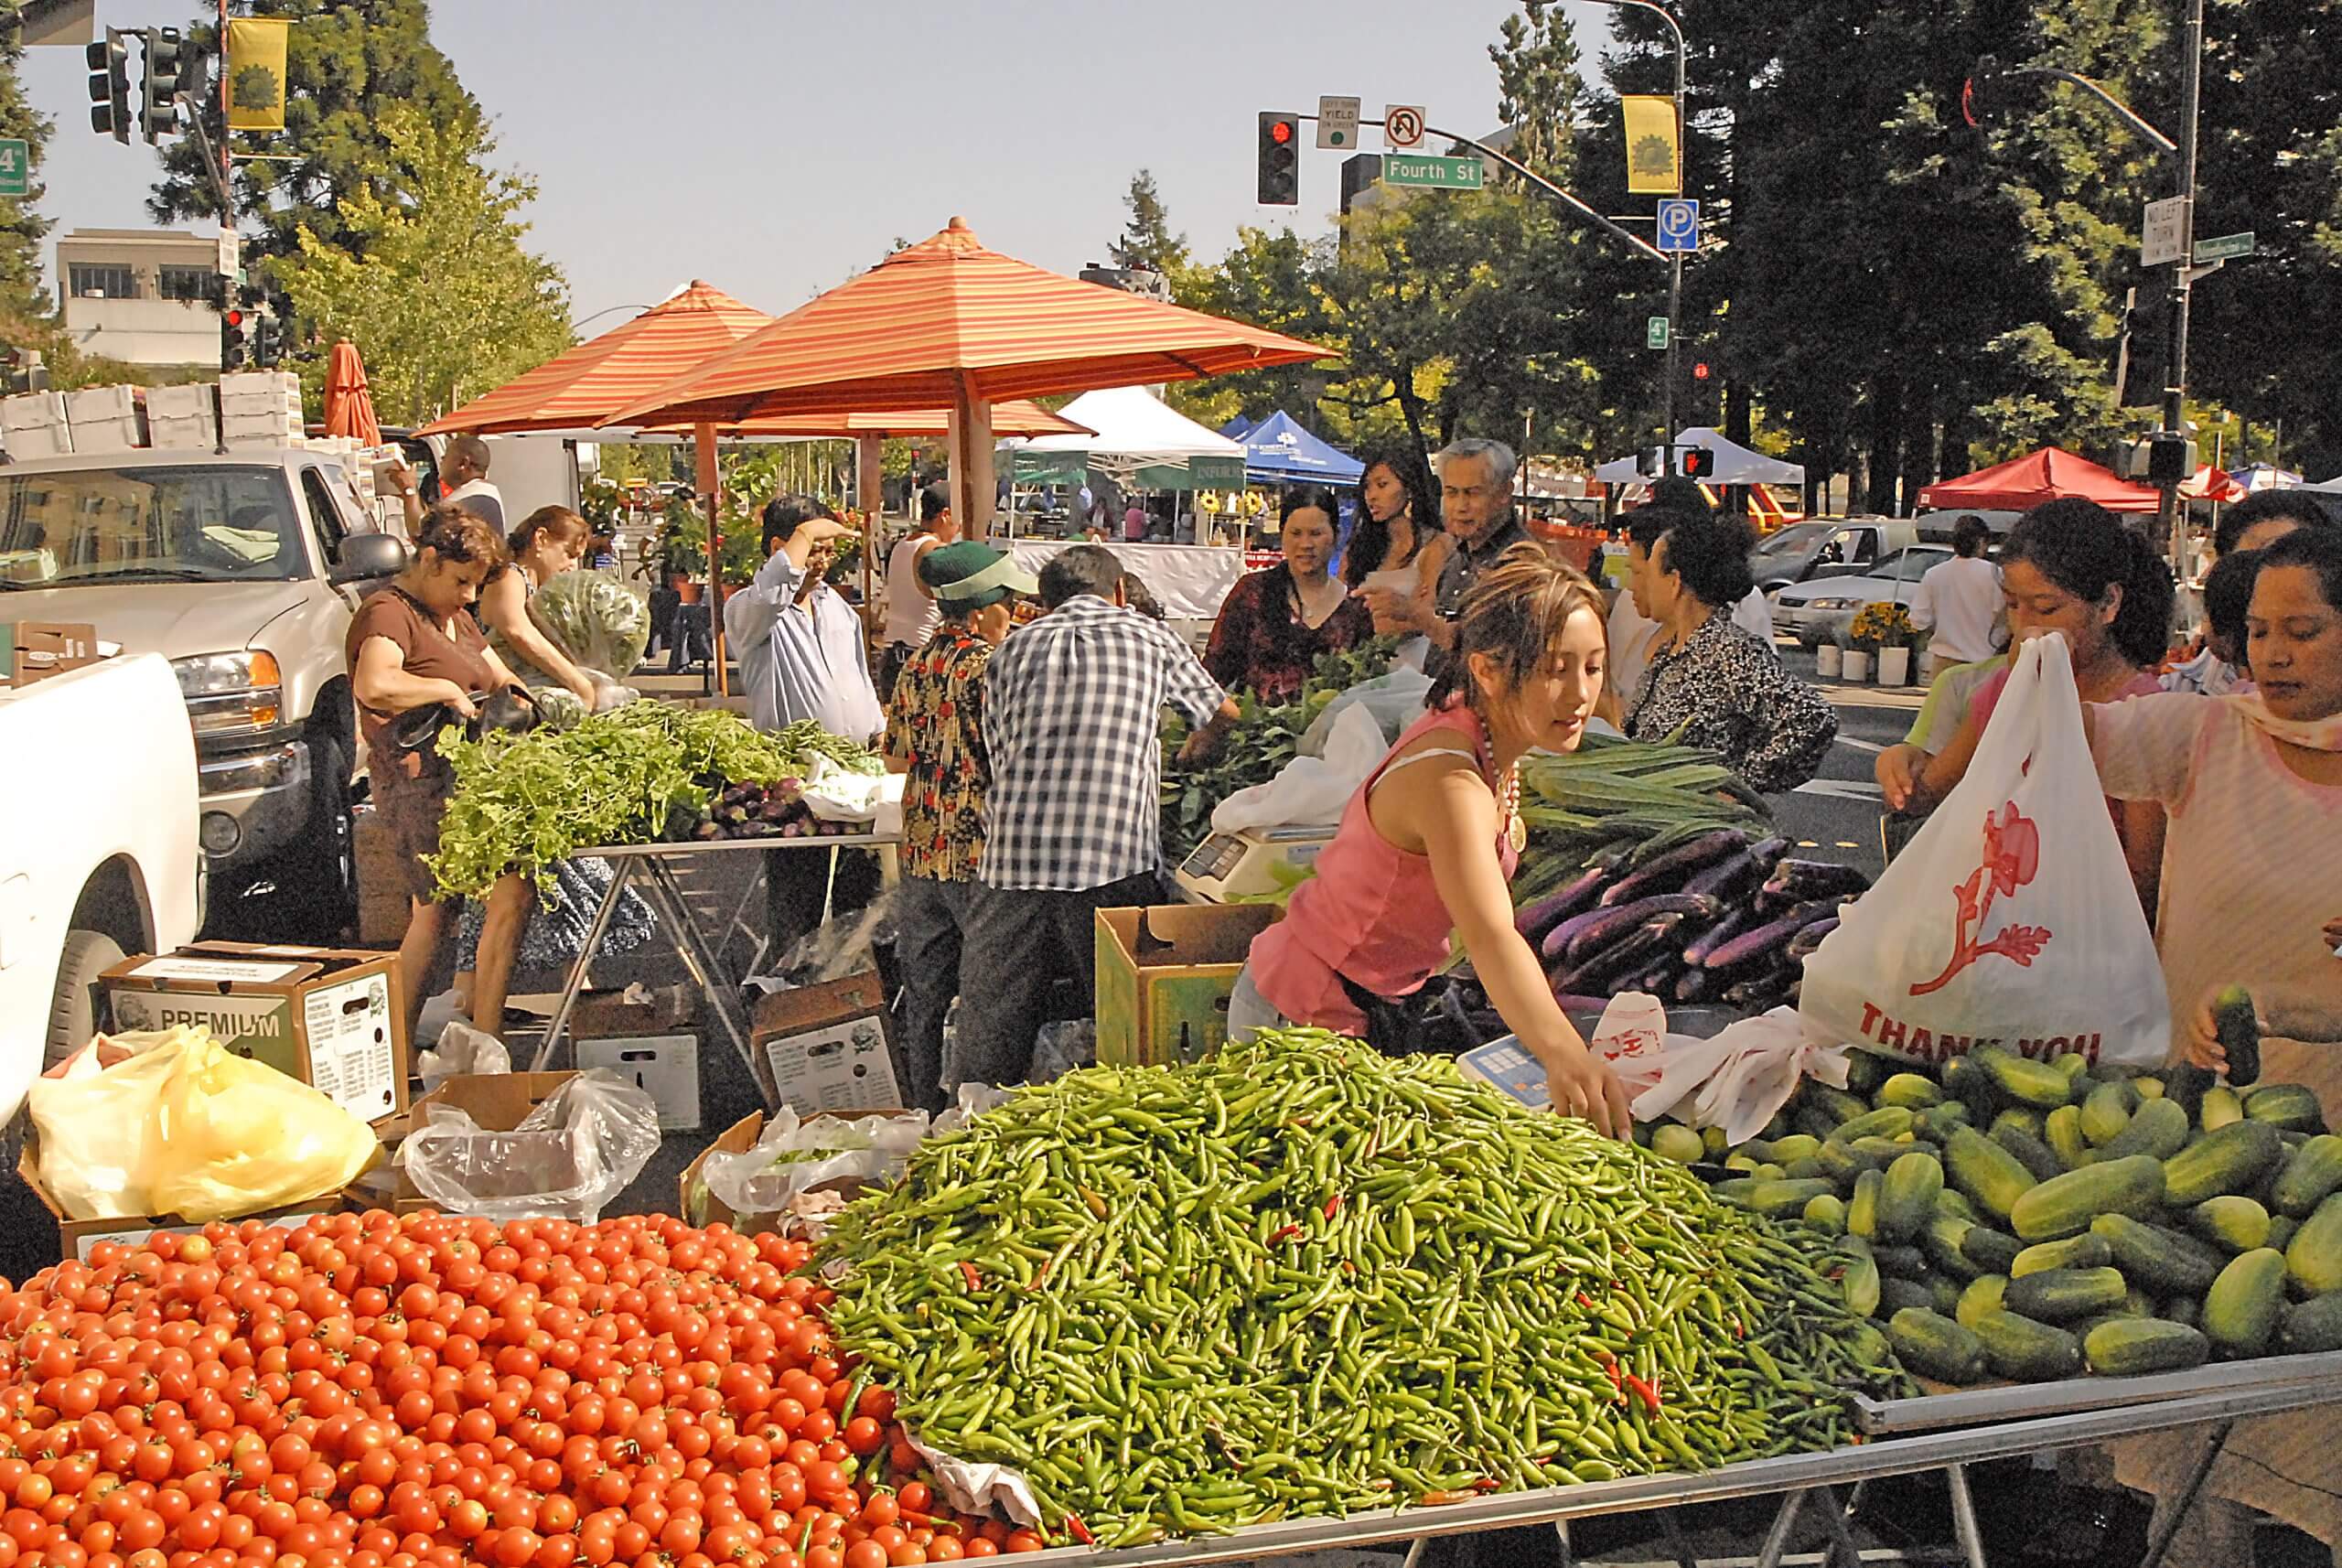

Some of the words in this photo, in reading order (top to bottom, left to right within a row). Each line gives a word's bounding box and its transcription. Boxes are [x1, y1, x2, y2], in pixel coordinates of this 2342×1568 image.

[1325, 110, 1354, 120] YIELD
[1390, 161, 1445, 179] Fourth
[1456, 165, 1475, 181] St
[1670, 208, 1690, 231] P
[160, 1008, 281, 1037] PREMIUM
[1859, 1001, 2004, 1063] THAN
[2017, 1032, 2101, 1069] YOU
